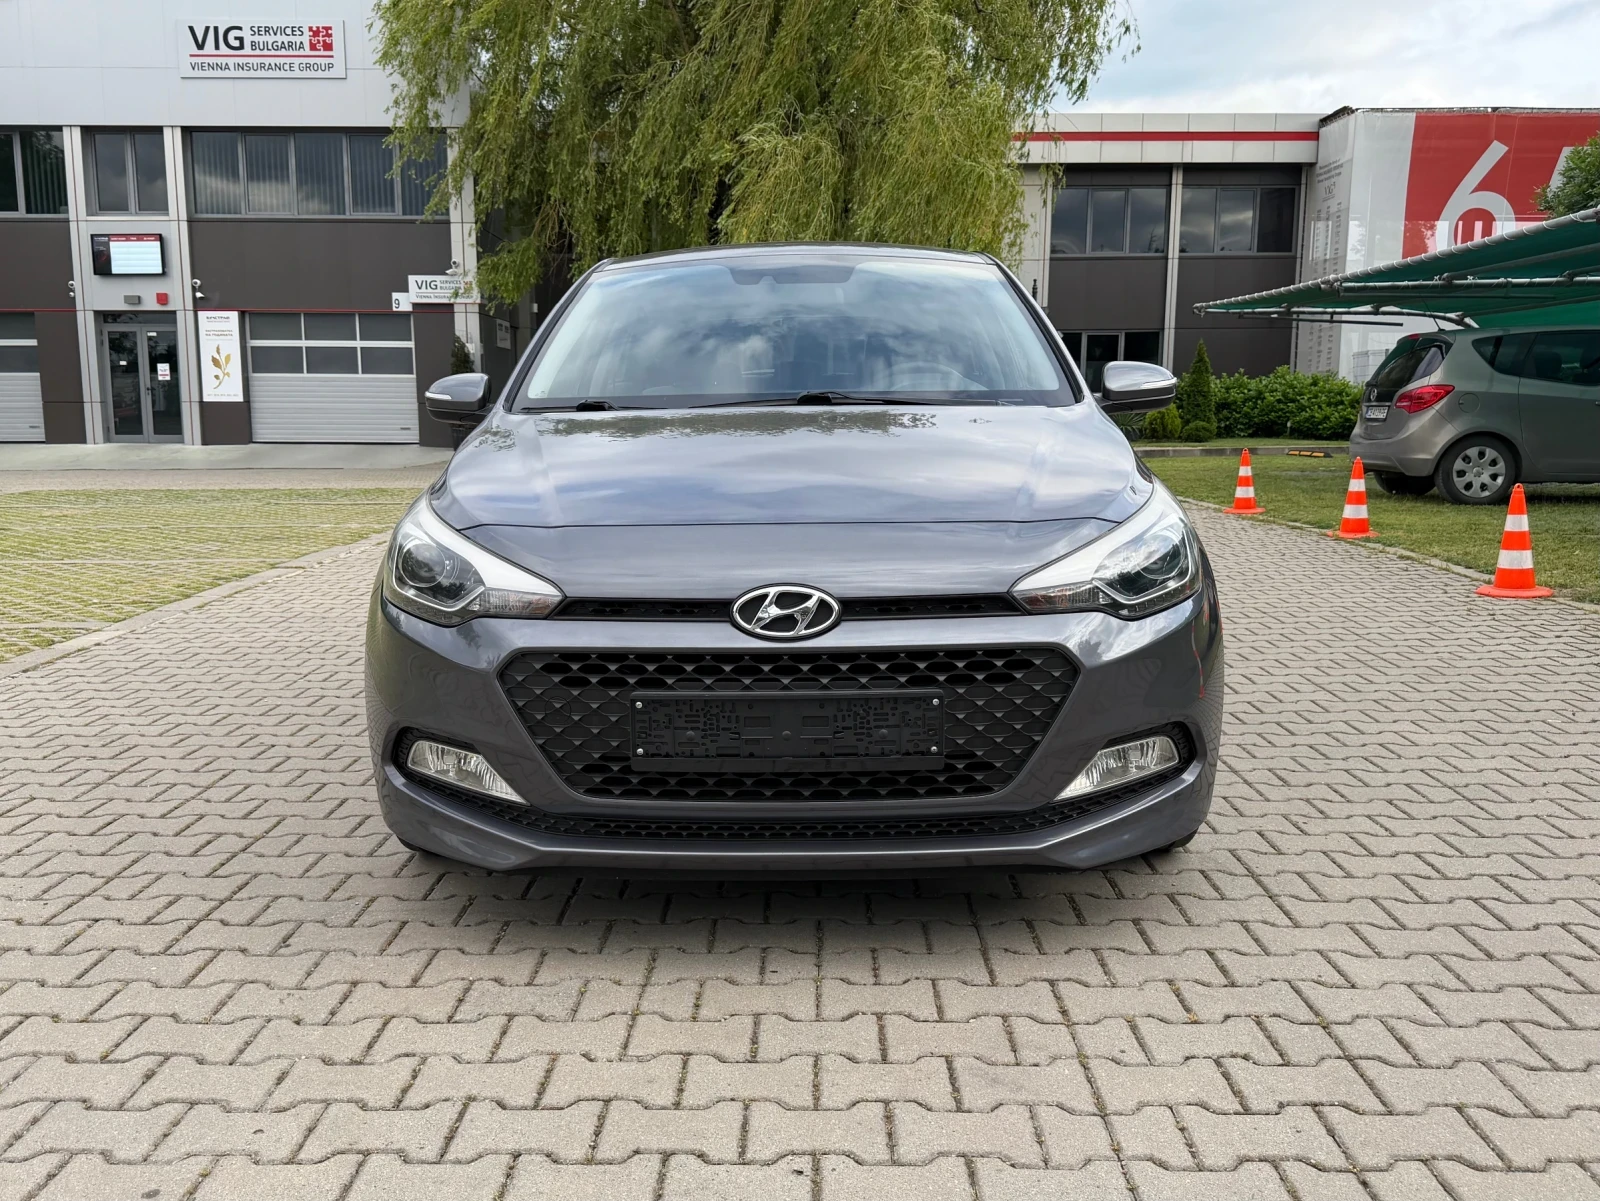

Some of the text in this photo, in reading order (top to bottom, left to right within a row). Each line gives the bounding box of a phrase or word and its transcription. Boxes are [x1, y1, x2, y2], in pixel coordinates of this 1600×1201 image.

[249, 26, 304, 37] SERVICES
[188, 25, 245, 51] VIG
[250, 41, 305, 51] BULGARIA
[190, 62, 334, 72] VIENNA INSURANCE GROUP
[415, 280, 438, 290] VIG
[394, 298, 400, 309] 9
